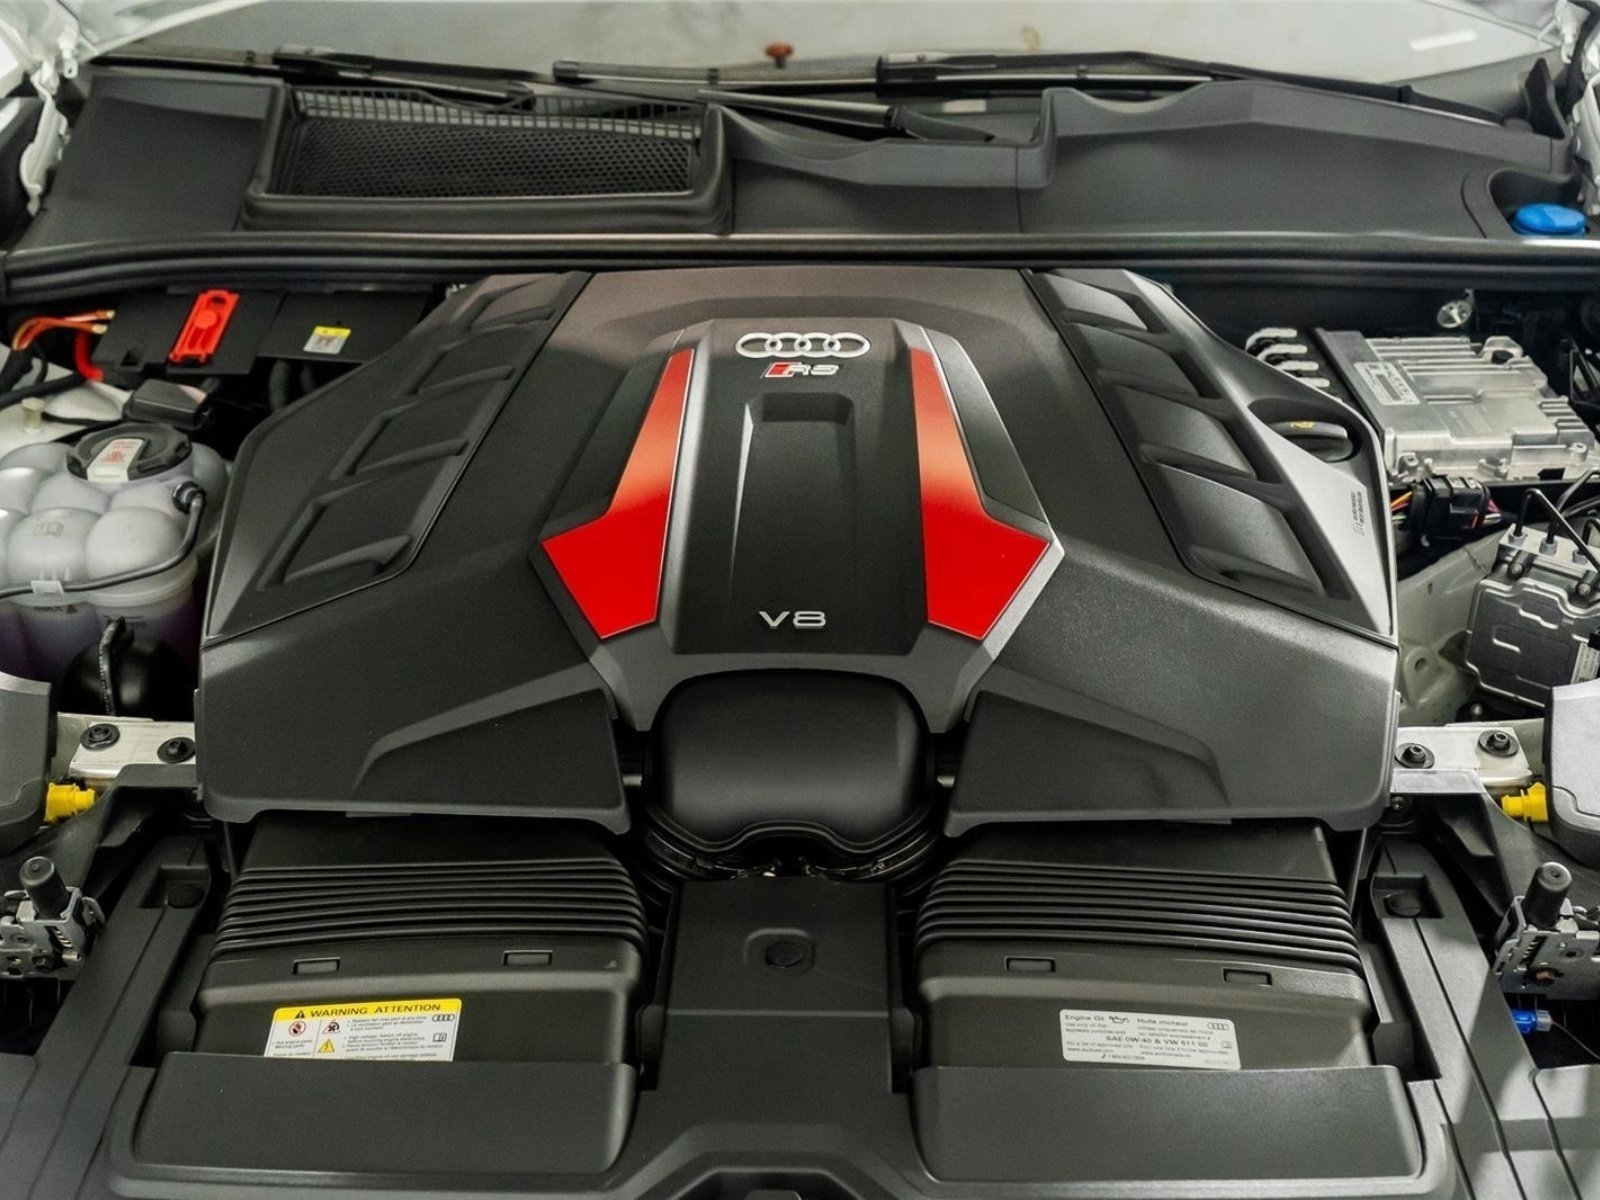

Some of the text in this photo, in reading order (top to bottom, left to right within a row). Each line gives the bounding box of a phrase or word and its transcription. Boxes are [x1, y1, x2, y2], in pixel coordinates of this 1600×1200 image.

[759, 610, 826, 629] V8
[310, 1003, 441, 1018] WARNING ATTENTION
[1065, 1014, 1092, 1022] Engine
